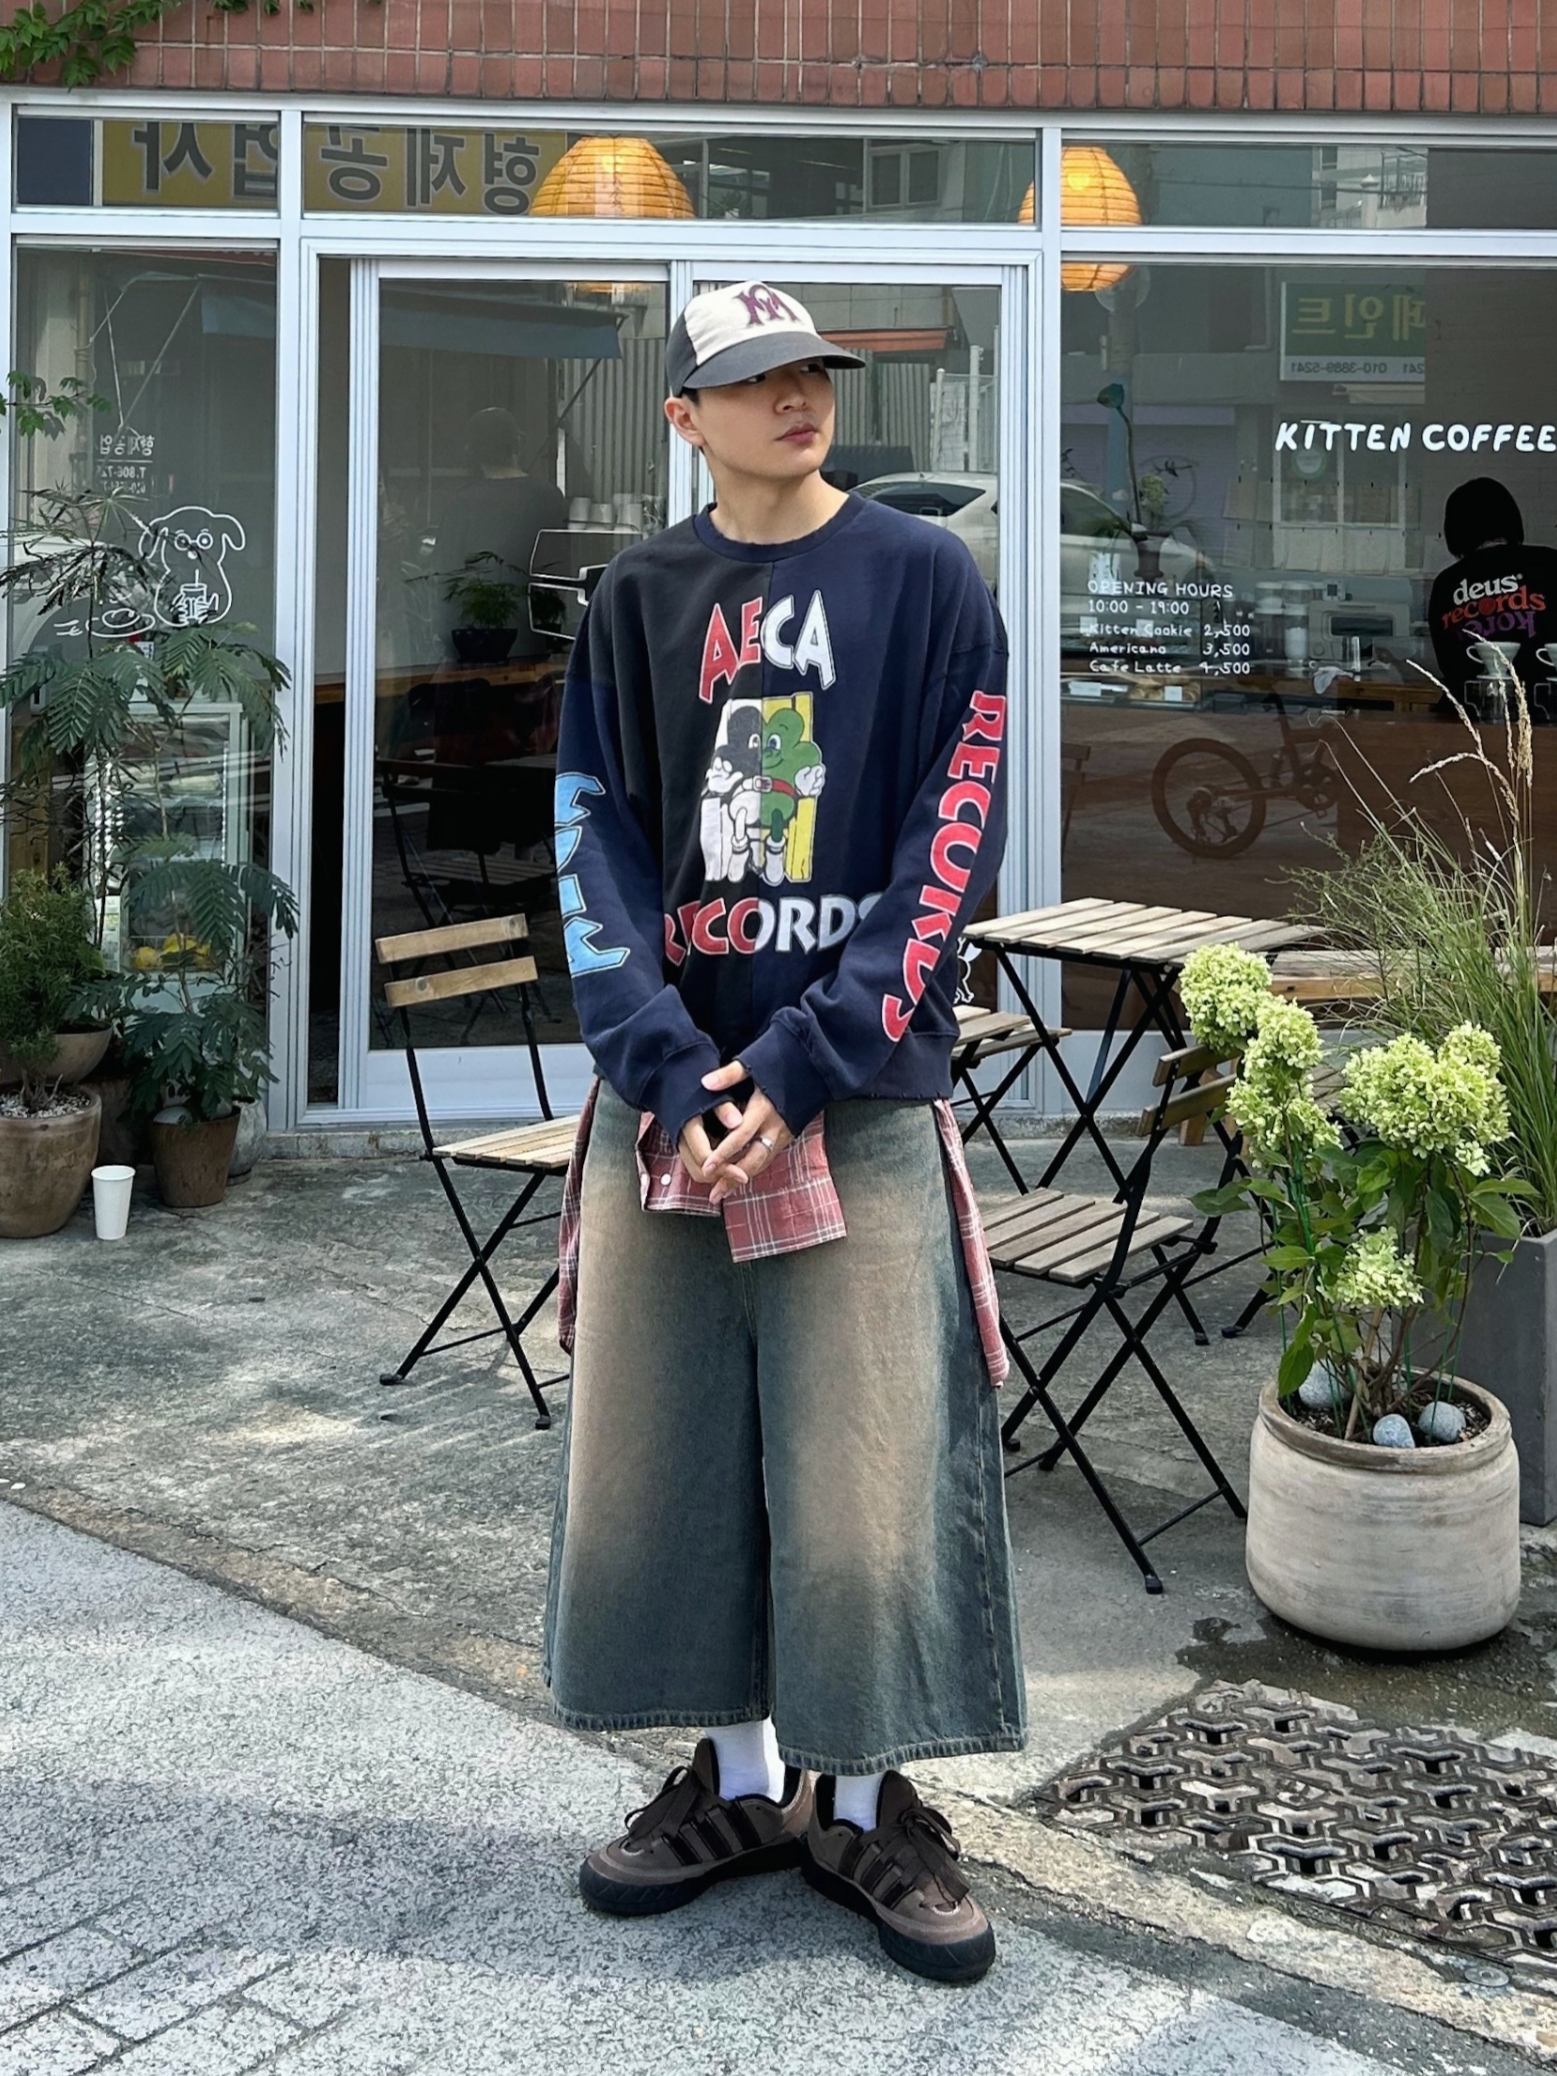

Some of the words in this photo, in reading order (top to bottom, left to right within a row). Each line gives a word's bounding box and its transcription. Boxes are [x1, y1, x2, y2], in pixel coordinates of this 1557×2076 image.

[1275, 422, 1411, 452] KITTEN
[1422, 423, 1557, 452] COFFEE
[1087, 580, 1168, 595] OPENING
[1175, 583, 1234, 598] HOURS
[1453, 574, 1519, 605] deus
[1088, 600, 1128, 614] 10:00
[1150, 601, 1189, 615] 19:00
[1088, 623, 1138, 636] Kitten
[1144, 624, 1192, 637] Cookie
[1203, 624, 1250, 638] 2,500
[699, 589, 836, 703] AECA
[1089, 642, 1166, 654] Americano
[1203, 643, 1250, 658] 3,500
[1089, 660, 1129, 673] Cafe
[1135, 661, 1181, 673] Latte
[1199, 661, 1250, 676] 4,500
[663, 892, 884, 967] RCORD
